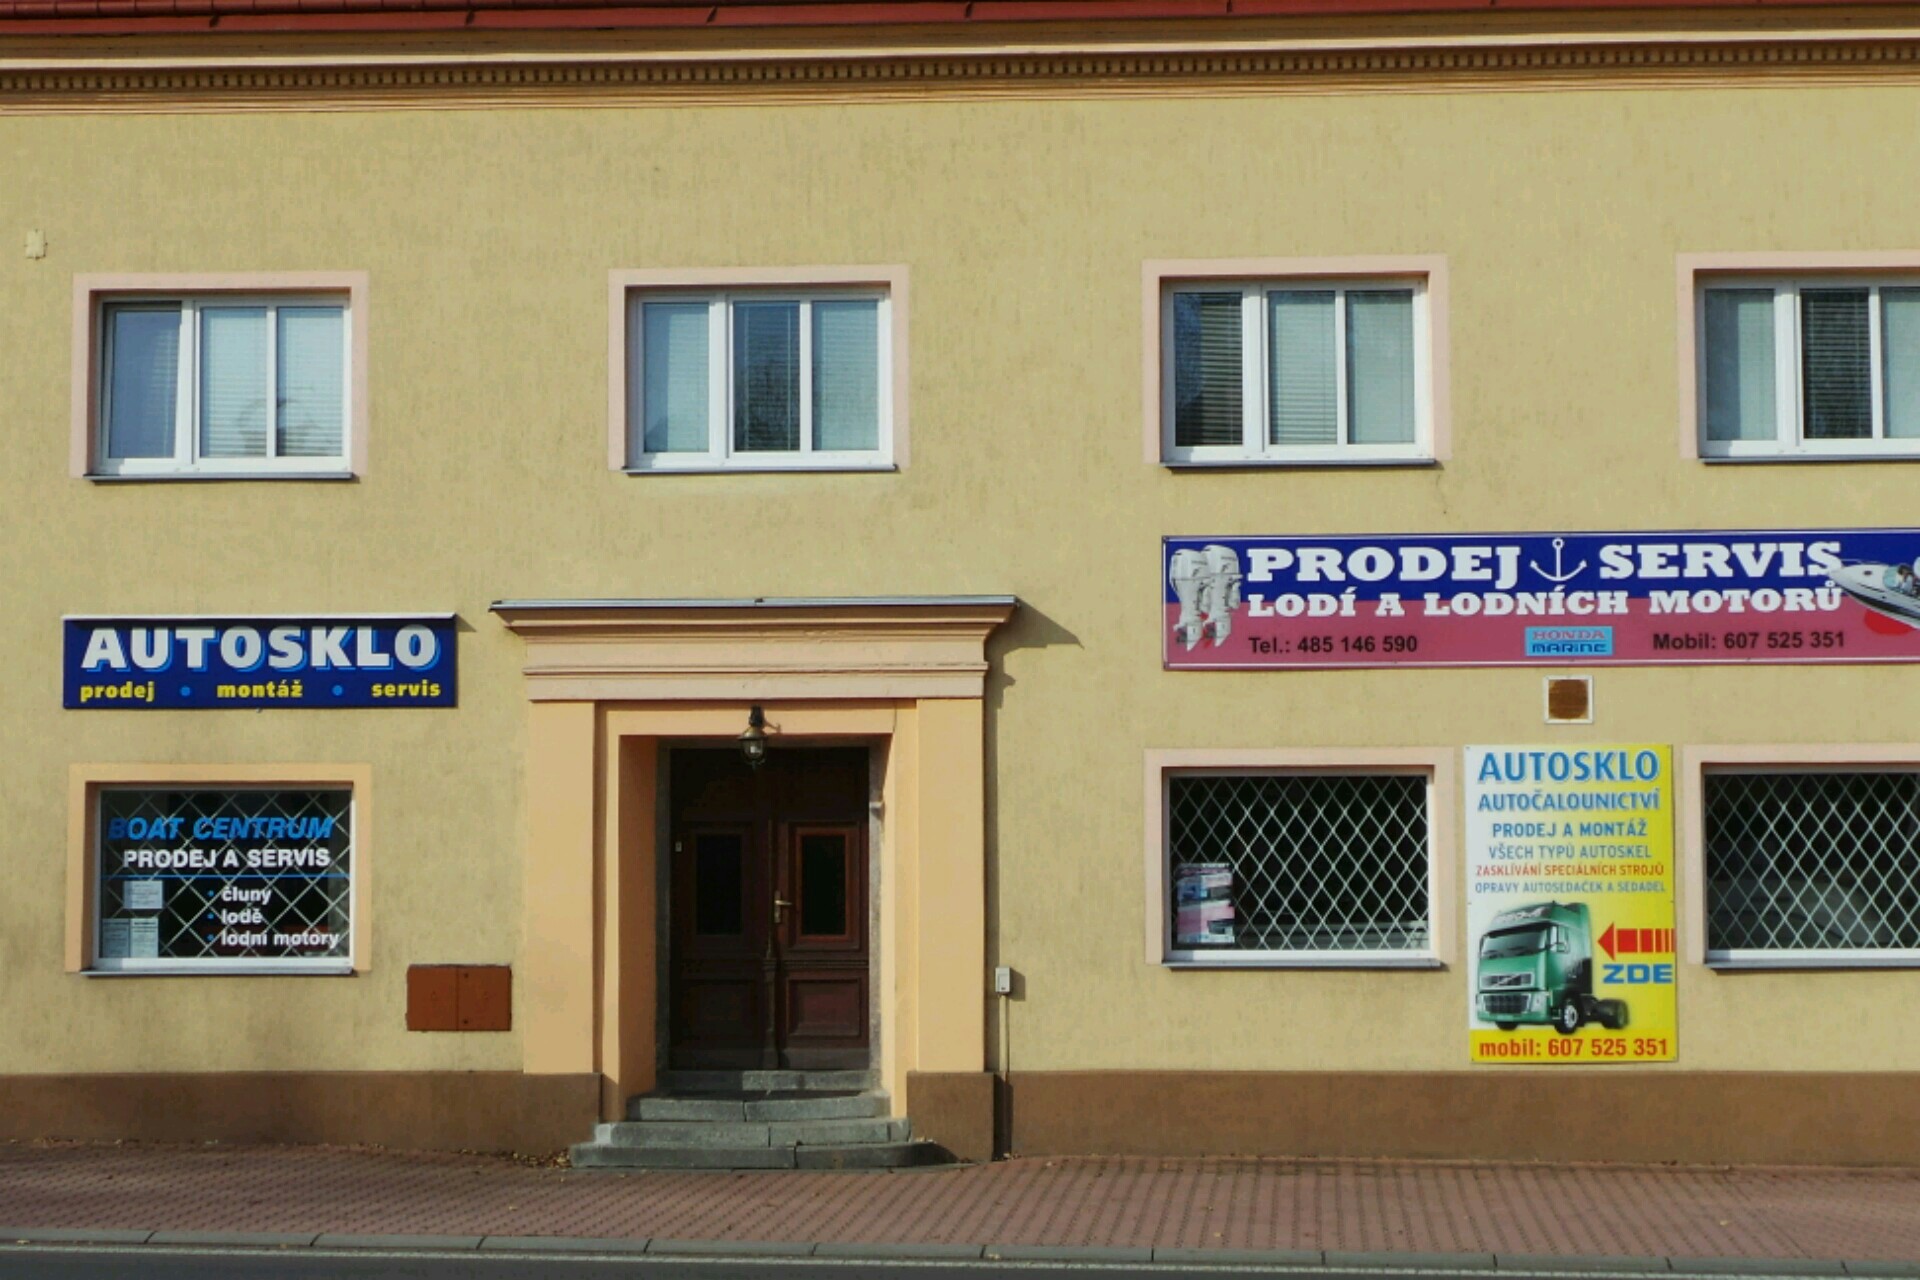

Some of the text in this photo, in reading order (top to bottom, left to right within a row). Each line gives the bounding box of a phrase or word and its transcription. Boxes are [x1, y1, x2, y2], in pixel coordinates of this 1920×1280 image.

[1247, 541, 1842, 589] PRODEJ SERVIS
[1248, 580, 1842, 617] LODÍ A LODNÍCH MOTORŮ
[1249, 635, 1418, 654] Tel.: 485 146 590
[1532, 630, 1605, 640] HONDA
[1652, 631, 1844, 651] Mobil: 607 525 351
[80, 625, 441, 673] AUTOSKLO
[80, 679, 441, 702] prodej montáž servis
[1477, 750, 1659, 782] AUTOSKLO
[1477, 788, 1661, 812] AUTOČALOUNICTVÍ
[108, 816, 335, 841] BOAT CENTRUM
[1492, 818, 1649, 838] PRODEJ A MONTÁŽ
[123, 848, 332, 869] PRODEJ A SERVIS
[1488, 842, 1653, 860] VŠECH TYPŮ AUTOSKEL
[1476, 861, 1665, 877] ZASKLÍVÁNÍ SPECIÁLNÍCH STROJŮ
[221, 886, 273, 906] čluny
[1475, 881, 1520, 894] OPRAVY
[1607, 881, 1614, 892] A
[221, 907, 262, 925] lodě
[273, 931, 340, 949] motory
[1602, 963, 1674, 984] ZDE
[1479, 1038, 1668, 1057] mobil: 607 525 351
